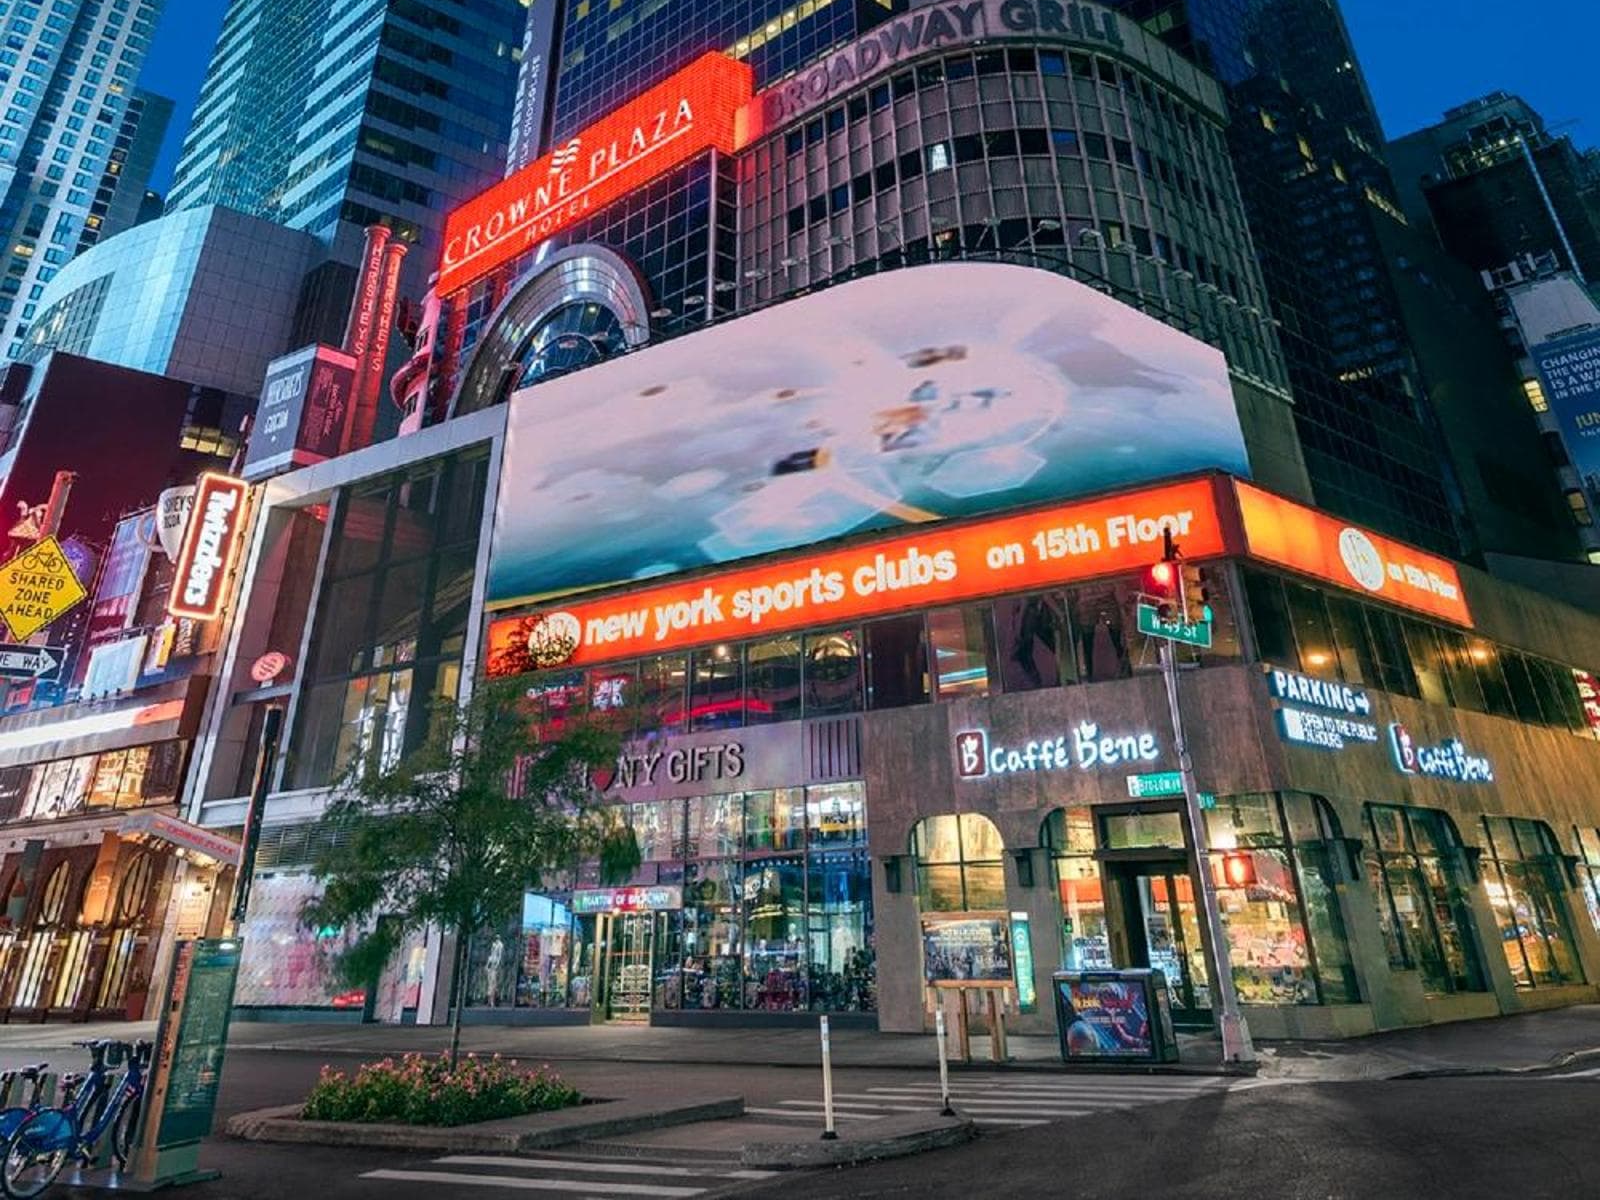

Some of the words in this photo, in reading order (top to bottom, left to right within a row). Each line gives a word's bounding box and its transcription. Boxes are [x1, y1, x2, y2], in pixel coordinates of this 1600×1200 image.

[762, 3, 984, 122] BROADWAY
[443, 168, 573, 266] CROWNE
[588, 98, 693, 180] PLAZA
[524, 194, 590, 244] HOTEL
[1545, 366, 1570, 380] THE
[986, 540, 1025, 570] on
[1031, 523, 1100, 560] 15th
[1106, 509, 1194, 548] Floor
[9, 571, 65, 591] SHARED
[14, 588, 51, 604] ZONE
[584, 608, 648, 646] new
[655, 590, 724, 641] york
[731, 569, 845, 623] sports
[852, 547, 957, 597] clubs
[5, 605, 53, 620] AHEAD
[23, 655, 49, 669] WAY
[1275, 671, 1356, 713] PARKING
[616, 751, 664, 790] NY
[666, 742, 745, 785] GIFTS
[989, 736, 1069, 773] Caffé
